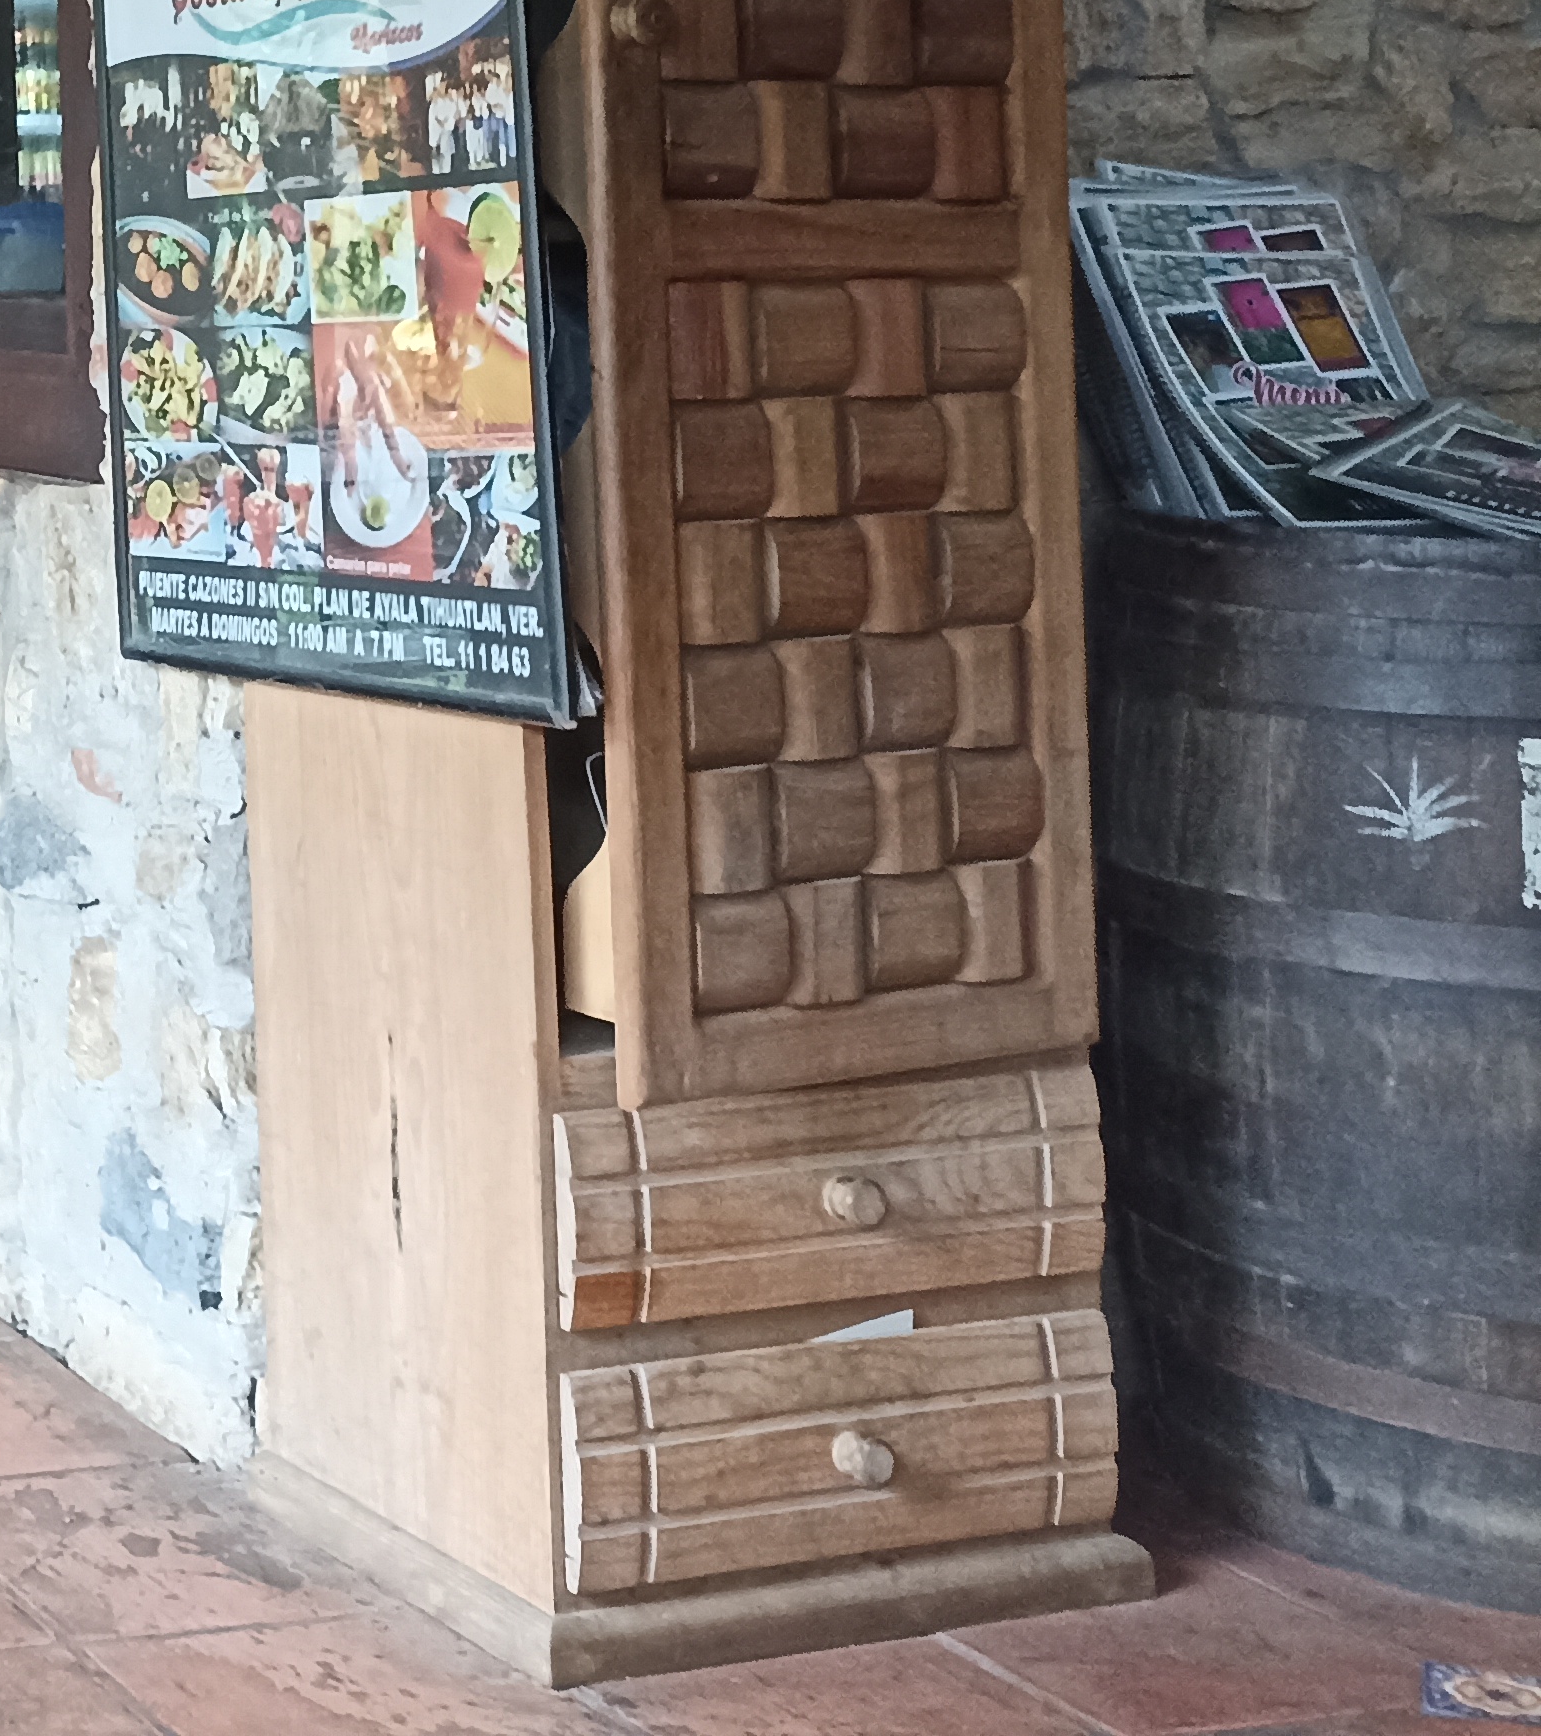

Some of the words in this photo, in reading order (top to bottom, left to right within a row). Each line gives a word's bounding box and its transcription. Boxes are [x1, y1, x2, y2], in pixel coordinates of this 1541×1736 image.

[138, 570, 186, 600] PUENTE
[188, 574, 245, 605] CAZONES
[313, 586, 349, 616] PLAN
[351, 589, 370, 618] DE
[373, 591, 419, 623] AYALA
[508, 604, 544, 637] VER.
[151, 606, 198, 637] MARTES
[200, 612, 209, 638] A
[211, 613, 278, 646] DOMINGOS
[325, 626, 348, 654] AM
[353, 628, 365, 657] A
[370, 629, 380, 657] 7
[382, 631, 405, 661] PM
[422, 635, 456, 667] TEL.
[458, 639, 475, 669] 11
